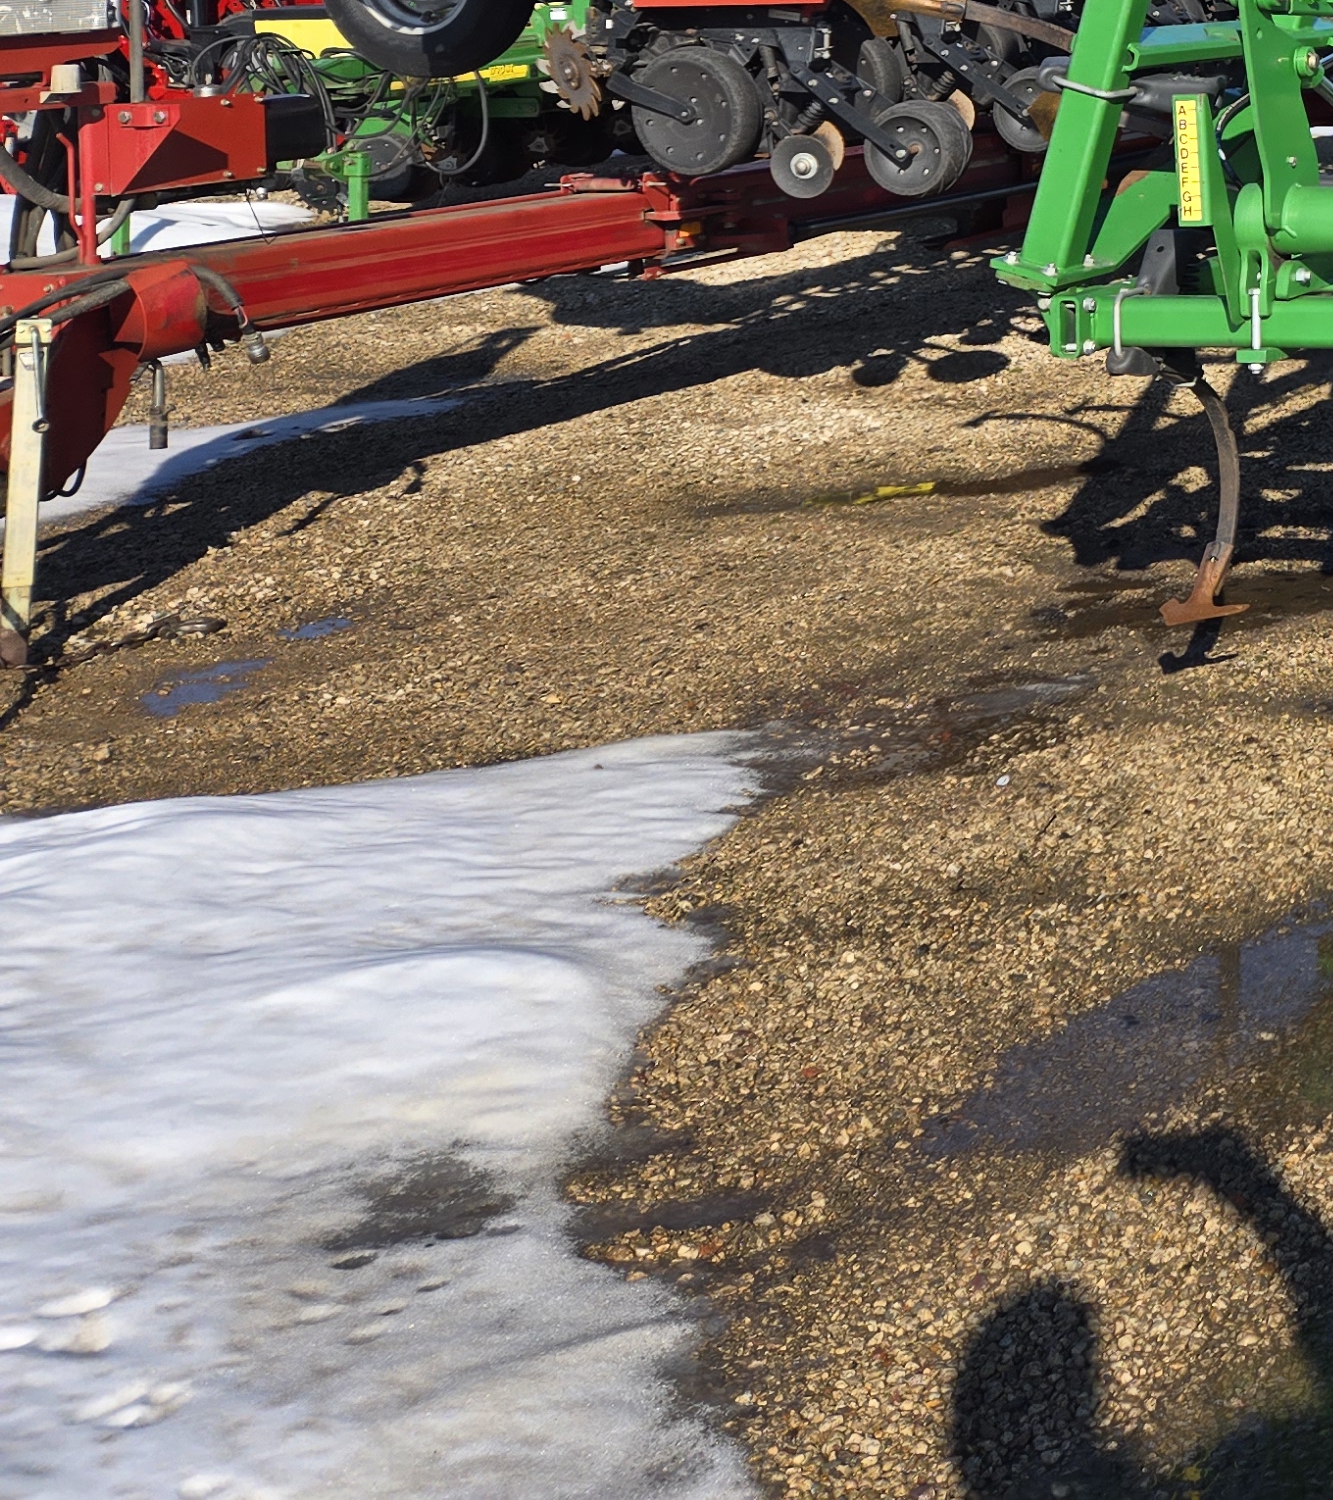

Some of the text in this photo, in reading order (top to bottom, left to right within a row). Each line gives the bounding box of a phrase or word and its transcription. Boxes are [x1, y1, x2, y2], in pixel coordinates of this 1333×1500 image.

[1178, 105, 1187, 116] A
[1179, 119, 1187, 131] B
[1179, 133, 1188, 145] C
[1180, 147, 1189, 160] D
[1181, 162, 1189, 174] E
[1181, 176, 1189, 188] F
[1182, 190, 1192, 203] G
[1183, 206, 1192, 217] H
